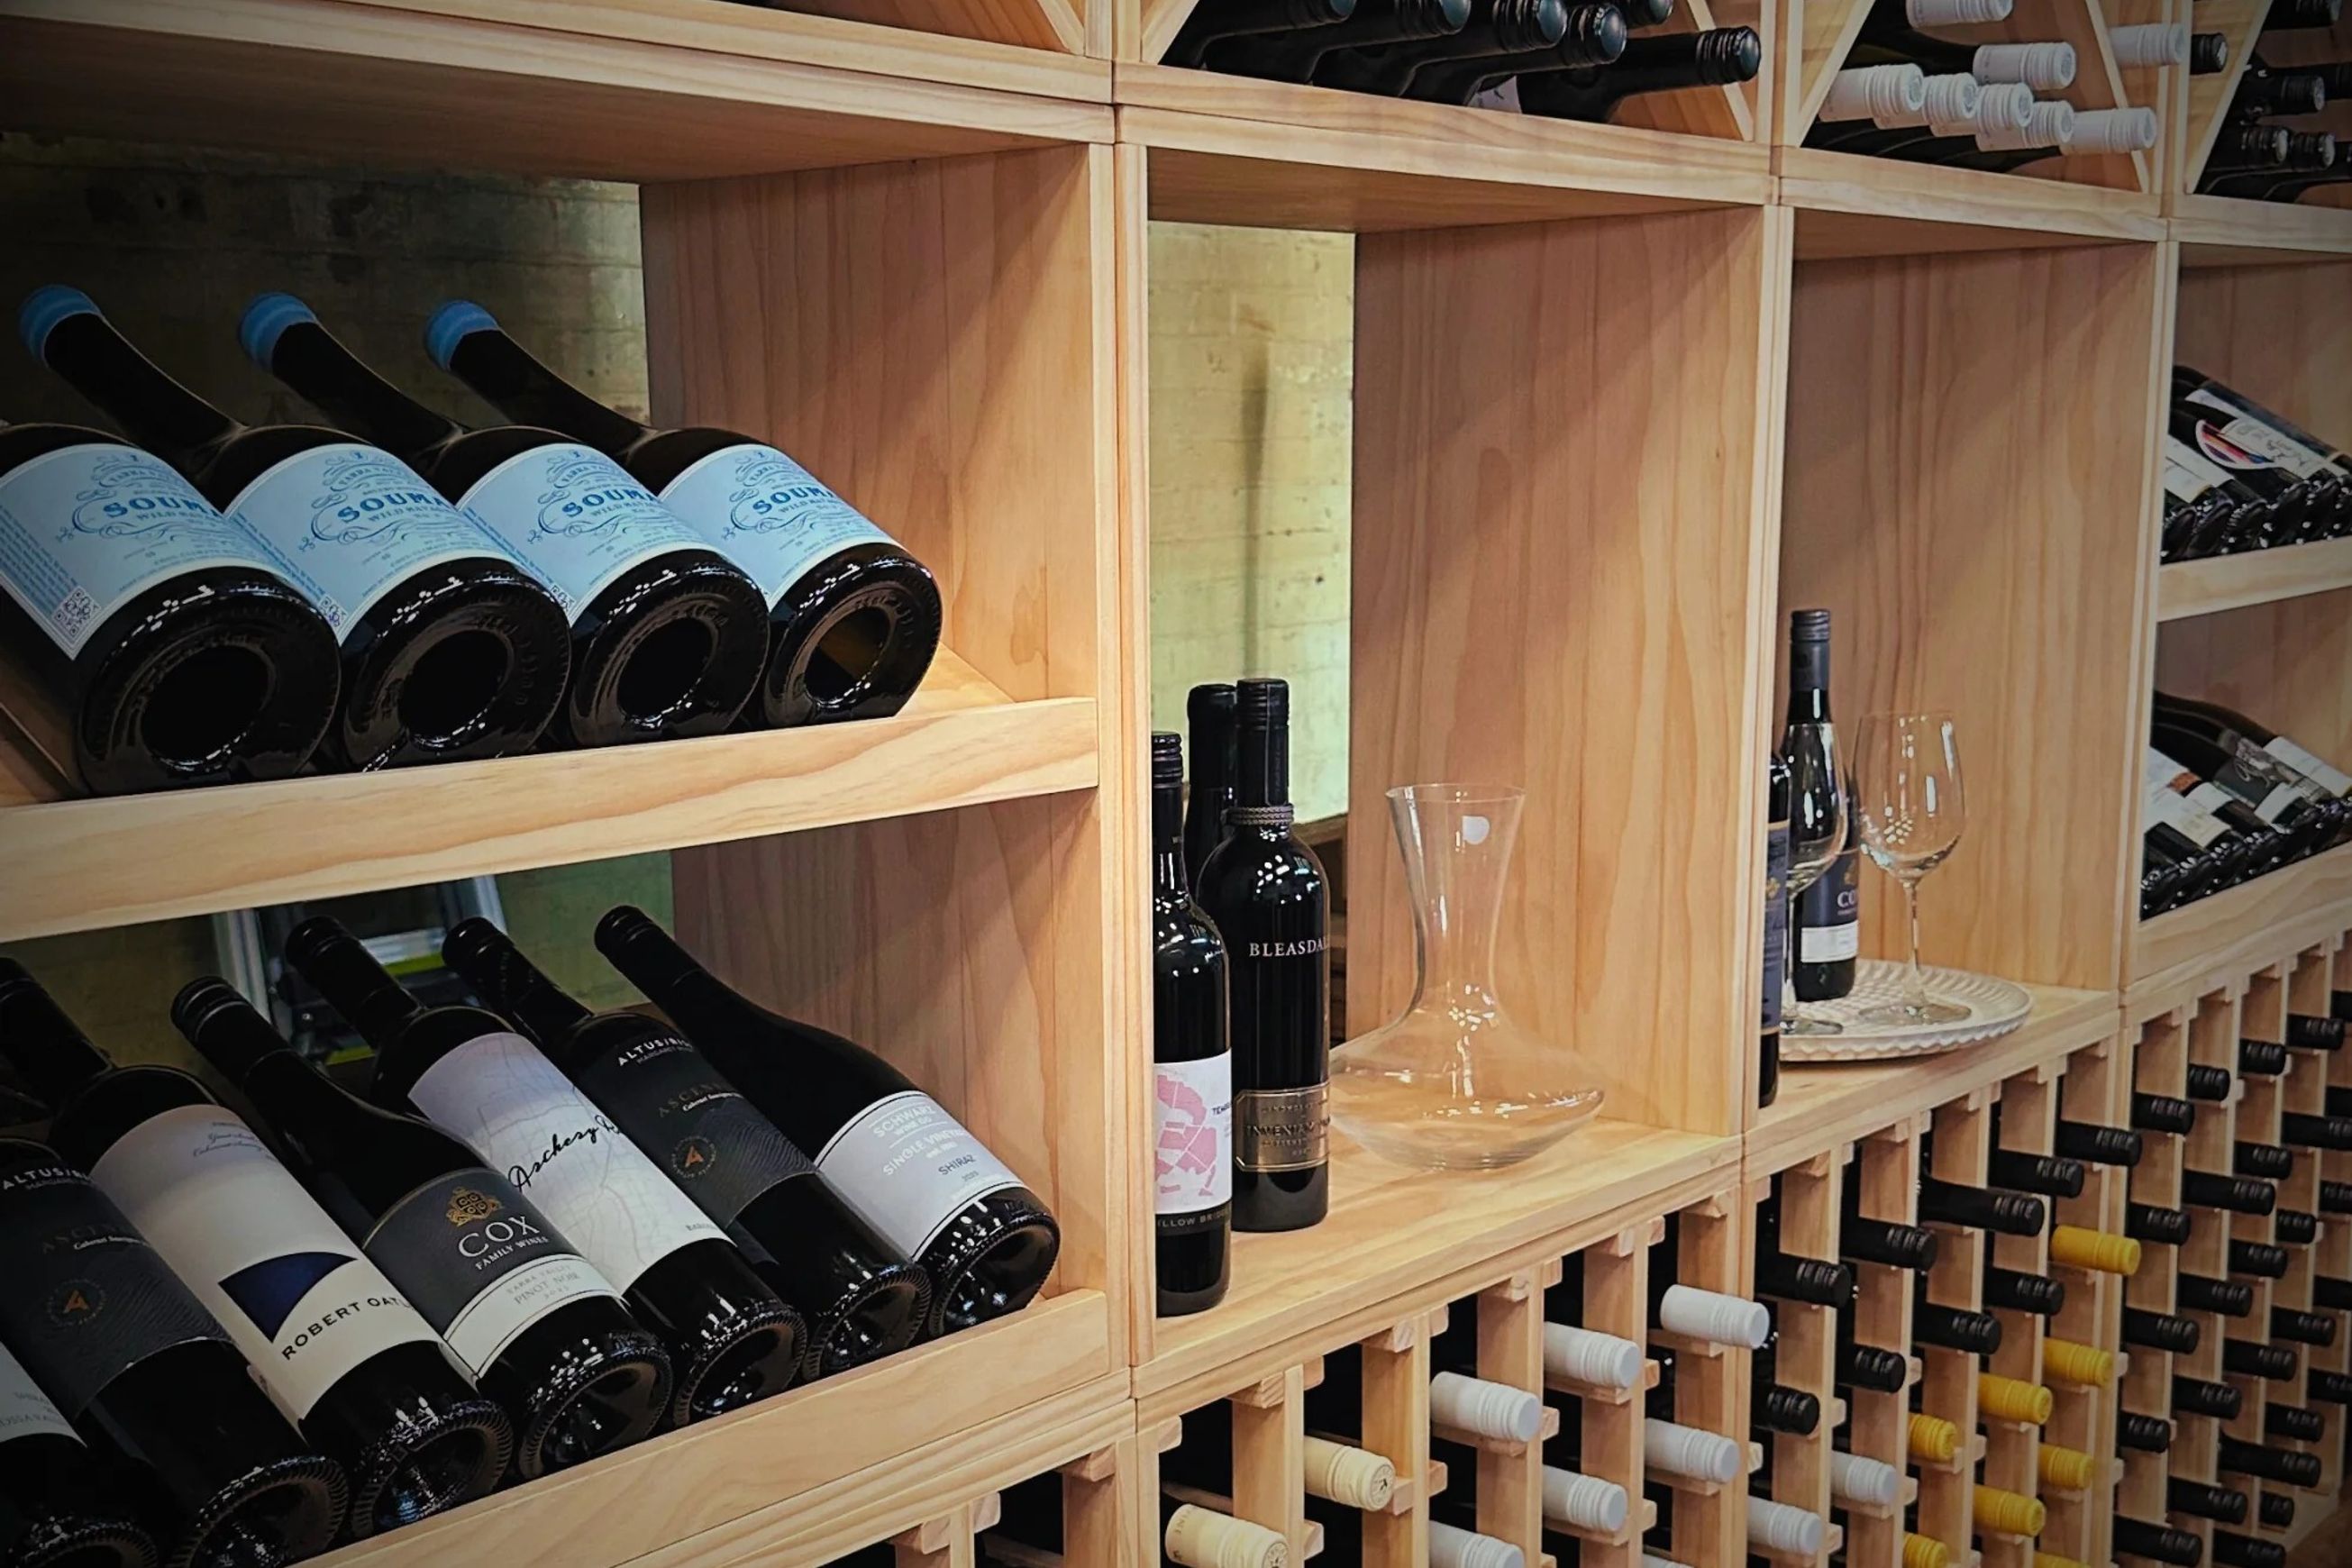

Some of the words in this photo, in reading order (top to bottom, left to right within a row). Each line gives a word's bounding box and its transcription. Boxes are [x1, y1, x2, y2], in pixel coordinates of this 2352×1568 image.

[882, 1139, 925, 1176] SINGLE
[937, 1153, 977, 1176] SHIRAZ
[458, 1216, 541, 1258] COX
[475, 1244, 515, 1271] FAMILY
[514, 1281, 550, 1305] PINOT
[282, 1301, 361, 1361] ROBERT
